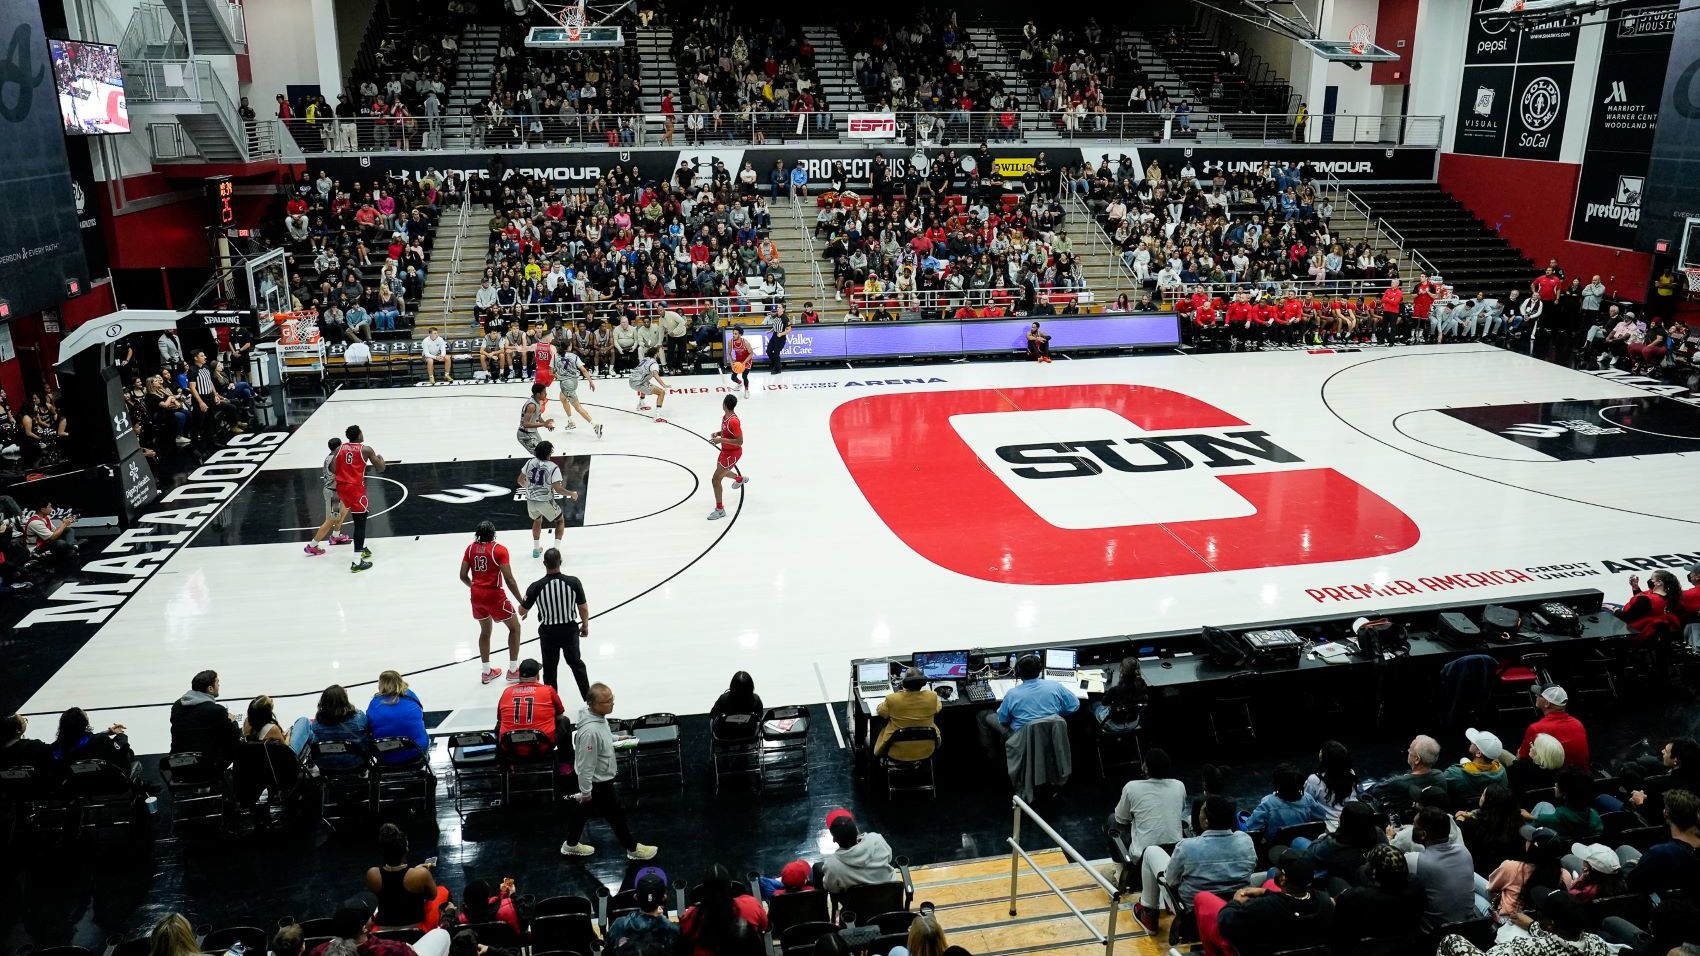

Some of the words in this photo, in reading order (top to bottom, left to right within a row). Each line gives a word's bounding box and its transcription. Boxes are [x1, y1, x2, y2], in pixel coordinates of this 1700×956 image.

[1477, 37, 1508, 55] pepsi
[849, 119, 895, 132] ESPN
[1465, 119, 1498, 128] VISUAL
[1525, 112, 1554, 127] GYM
[1518, 132, 1551, 148] SoCal
[881, 158, 905, 179] HIS
[204, 315, 240, 325] SPALDING
[793, 345, 812, 354] Care
[844, 377, 948, 387] ARENA
[345, 452, 354, 465] 6
[995, 430, 1305, 479] SUN
[13, 430, 290, 629] MATADORS
[474, 555, 488, 572] 13
[1525, 561, 1591, 574] CREDIT
[1535, 569, 1601, 581] UNION
[1305, 580, 1418, 604] PREMIER
[1418, 569, 1536, 593] AMERICA
[512, 696, 535, 725] 11
